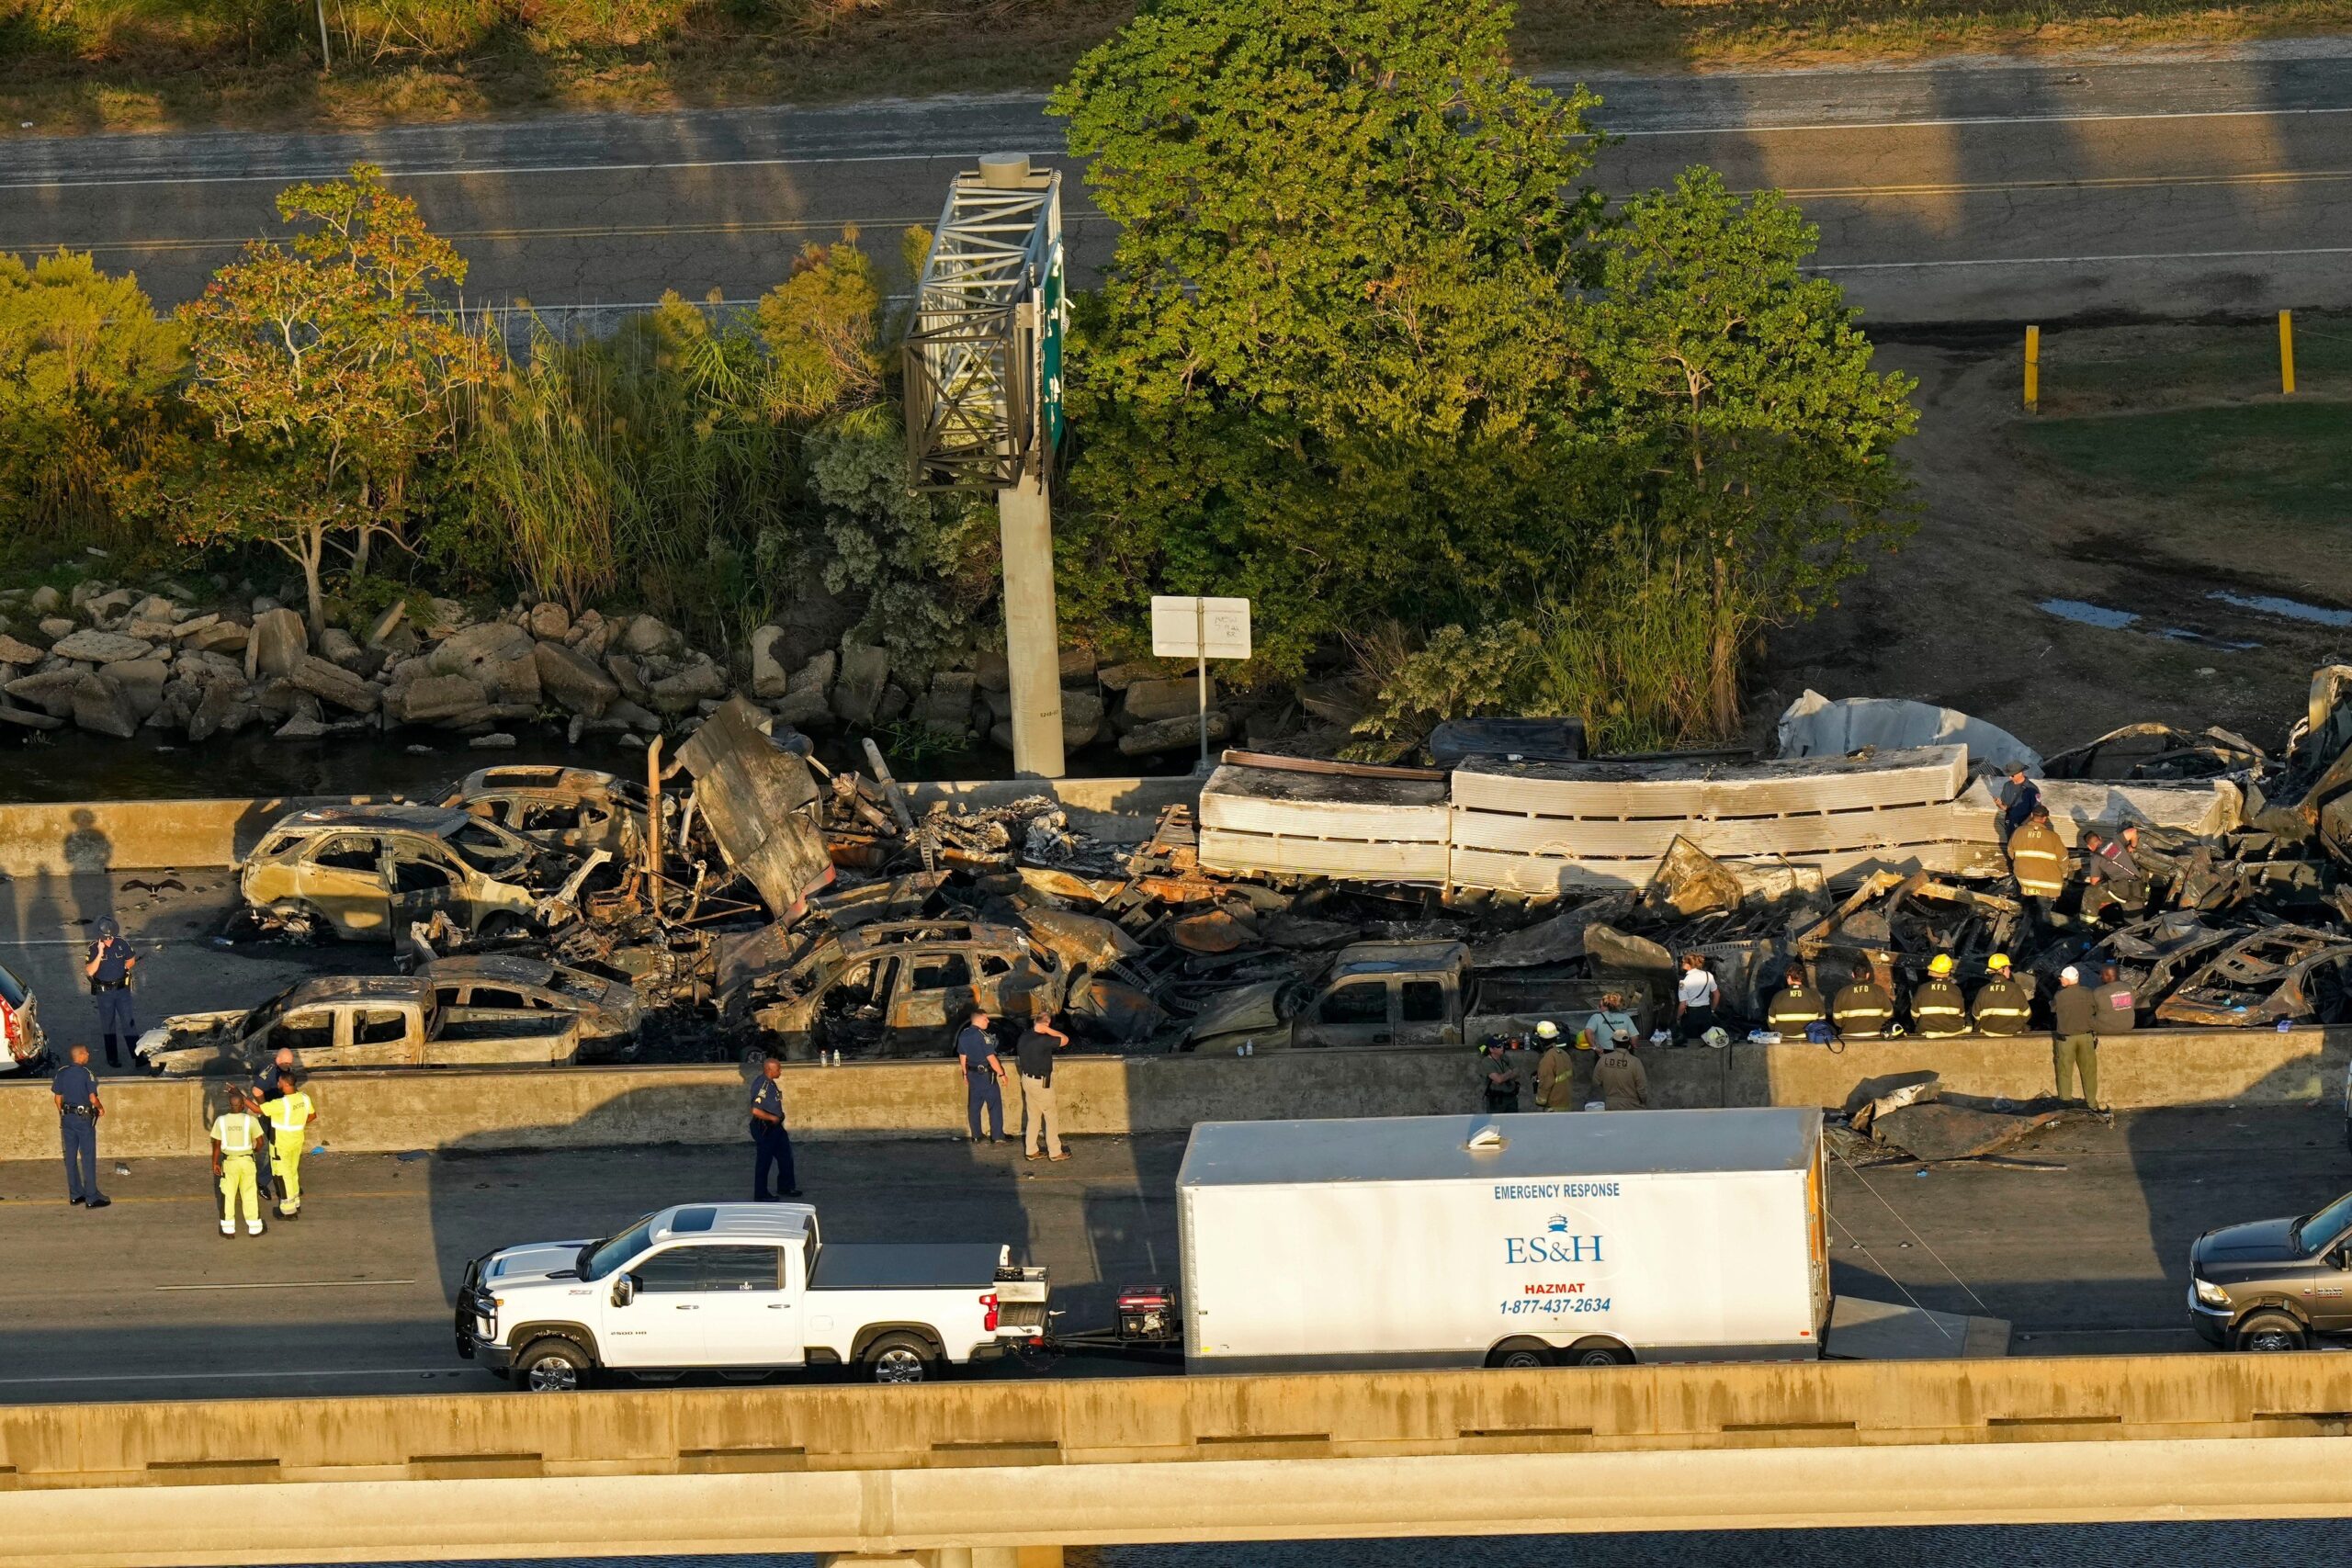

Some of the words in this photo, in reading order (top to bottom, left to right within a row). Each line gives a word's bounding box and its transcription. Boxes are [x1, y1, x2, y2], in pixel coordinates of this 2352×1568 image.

[1853, 985, 1869, 993] KFD
[1931, 983, 1947, 991] KFD
[1494, 1184, 1560, 1200] EMERGENCY
[1564, 1182, 1620, 1198] RESPONSE
[1504, 1235, 1605, 1265] ES&H
[1524, 1282, 1586, 1294] HAZMAT
[1499, 1297, 1611, 1314] 1-877-437-2634
